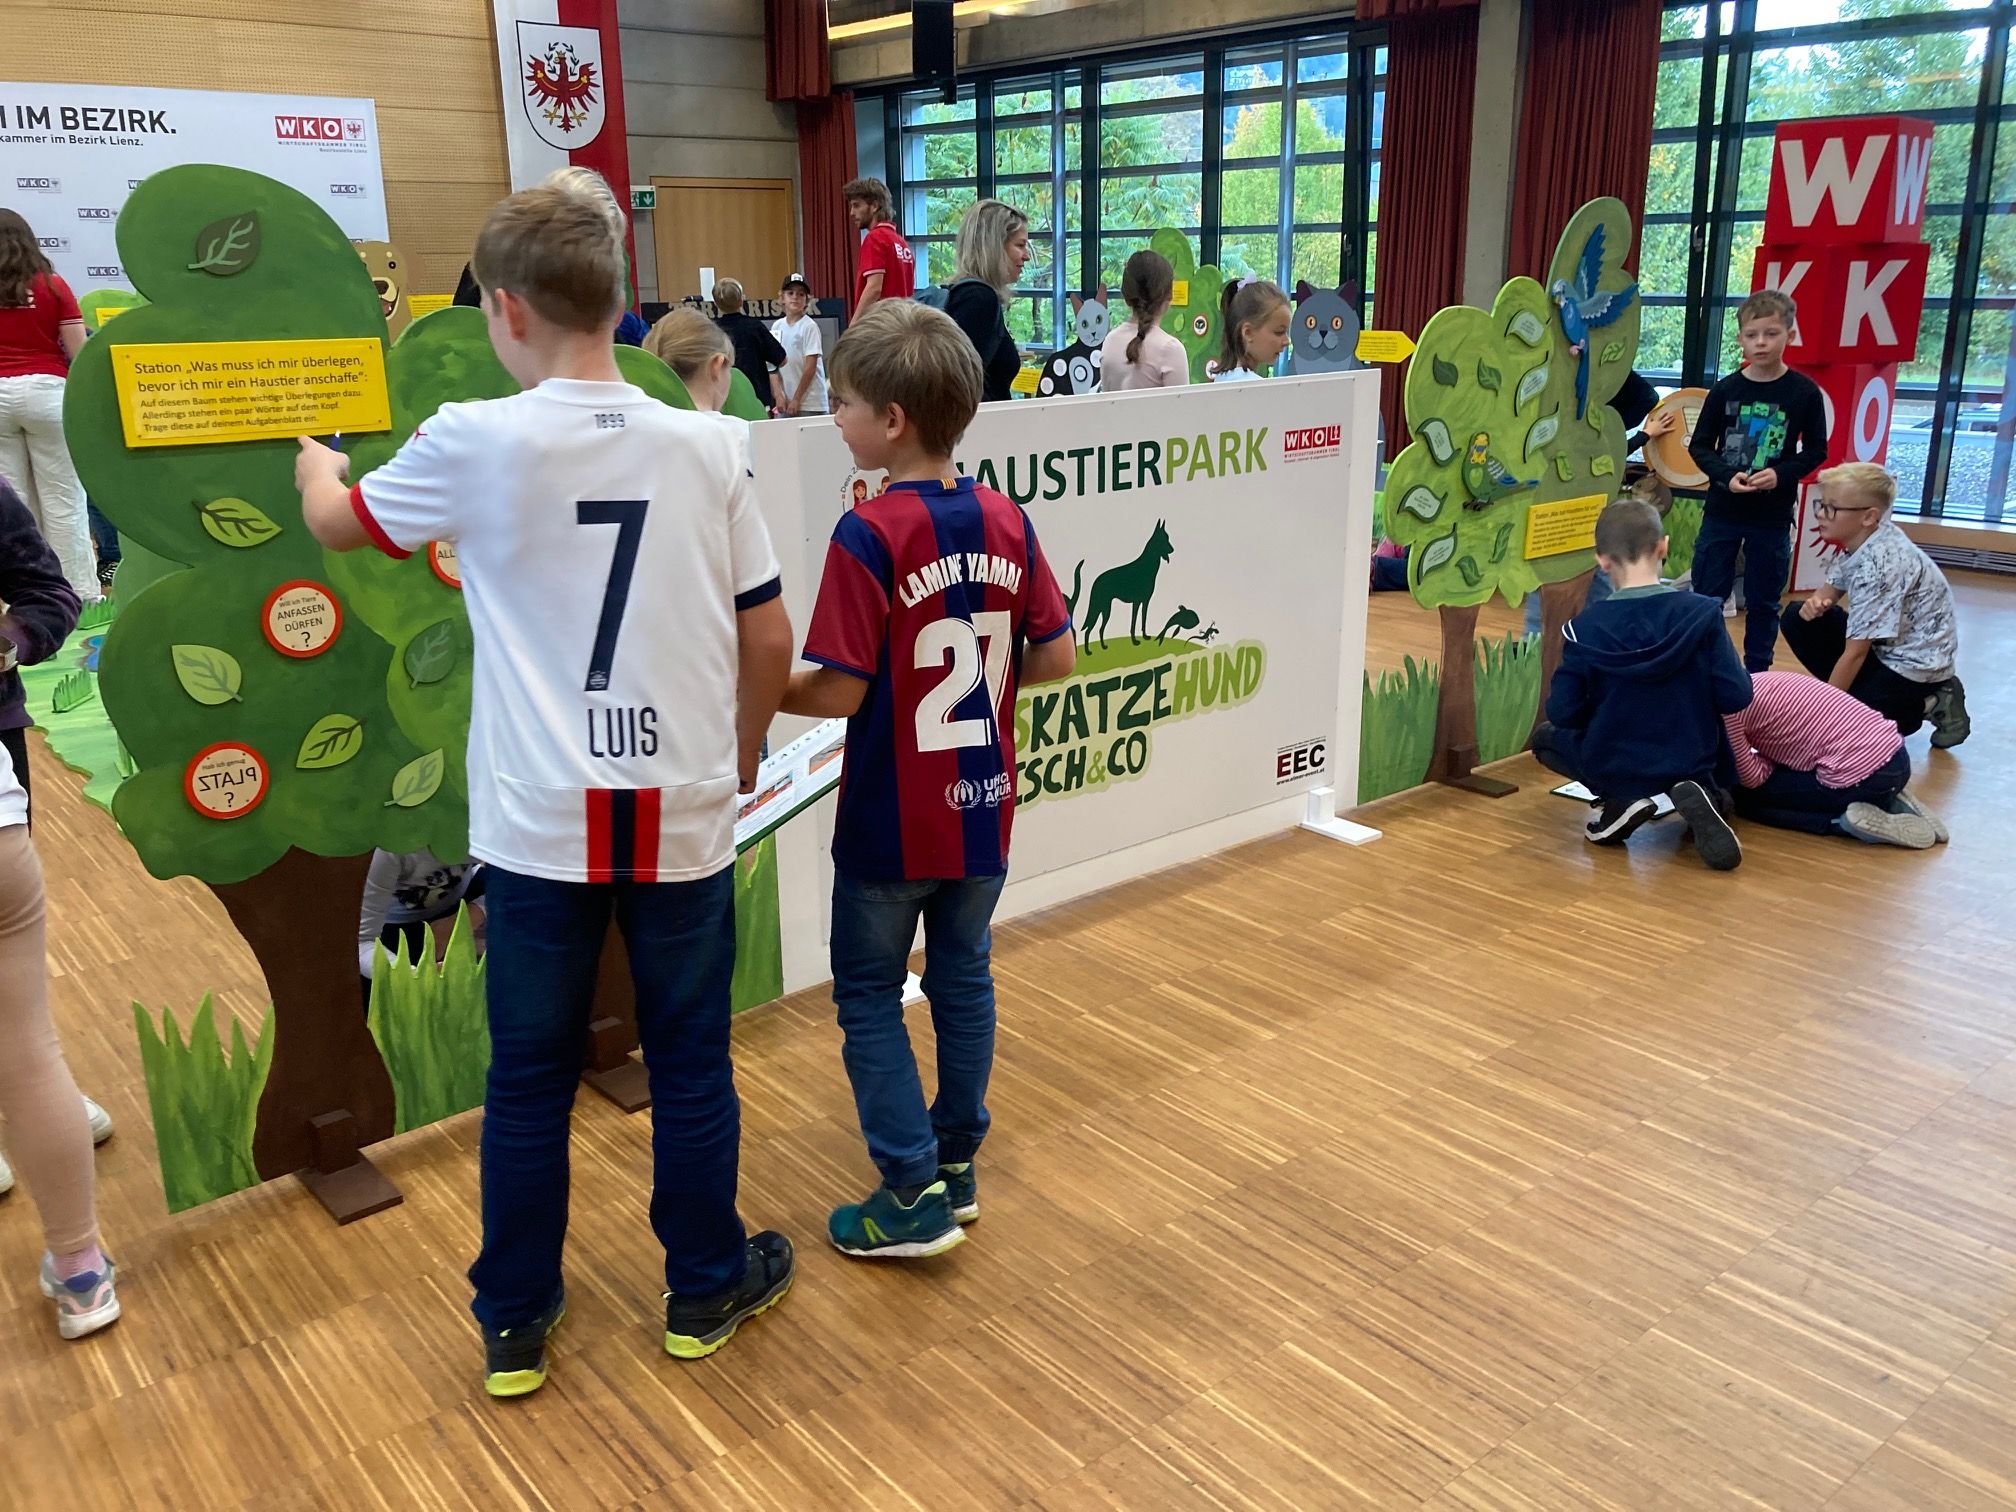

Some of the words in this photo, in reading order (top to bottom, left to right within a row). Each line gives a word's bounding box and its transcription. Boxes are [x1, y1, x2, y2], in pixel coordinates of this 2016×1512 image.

[16, 105, 51, 130] IM
[60, 106, 177, 134] BEZIRK.
[276, 118, 341, 138] WKO
[51, 134, 66, 144] im
[69, 134, 107, 145] Bezirk
[109, 136, 144, 146] Lienz.
[17, 178, 49, 188] WKO
[1779, 134, 1891, 227] W
[1894, 134, 1931, 225] W
[330, 185, 357, 193] WKO
[78, 208, 109, 218] WKO
[37, 238, 58, 247] KO
[88, 267, 118, 276] WKO
[1839, 259, 1910, 347] K
[135, 362, 182, 374] Station
[222, 360, 254, 371] muss
[257, 358, 275, 370] ich
[279, 357, 299, 368] mir
[302, 355, 364, 368] überlegen,
[138, 381, 176, 392] bevor
[180, 379, 199, 391] ich
[202, 378, 224, 389] mir
[227, 377, 246, 388] ein
[250, 376, 301, 387] Haustier
[141, 399, 156, 407] Auf
[158, 398, 190, 407] diesem
[193, 397, 217, 405] Baum
[219, 395, 248, 404] stehen
[249, 393, 284, 402] wichtige
[285, 391, 340, 400] Überlegungen
[142, 410, 186, 420] Allerdings
[188, 409, 217, 417] stehen
[219, 407, 232, 415] ein
[234, 407, 253, 416] paar
[255, 404, 284, 413] Wörter
[286, 403, 299, 412] auf
[301, 402, 319, 411] dem
[144, 424, 169, 433] Trage
[170, 422, 194, 431] diese
[196, 421, 210, 429] auf
[211, 419, 244, 428] deinem
[246, 415, 302, 426] Aufgabenblatt
[956, 427, 1268, 505] AUSTIERPARK
[898, 553, 963, 608] LAMINE
[966, 552, 1023, 595] YAMAL
[576, 500, 650, 692] 7
[277, 603, 325, 620] ANFASSEN
[284, 617, 323, 632] DÜRFEN
[300, 631, 311, 648] ?
[913, 610, 1013, 752] 27
[587, 706, 659, 758] LUIS
[1277, 744, 1325, 778] EEC
[223, 792, 234, 808] ?
